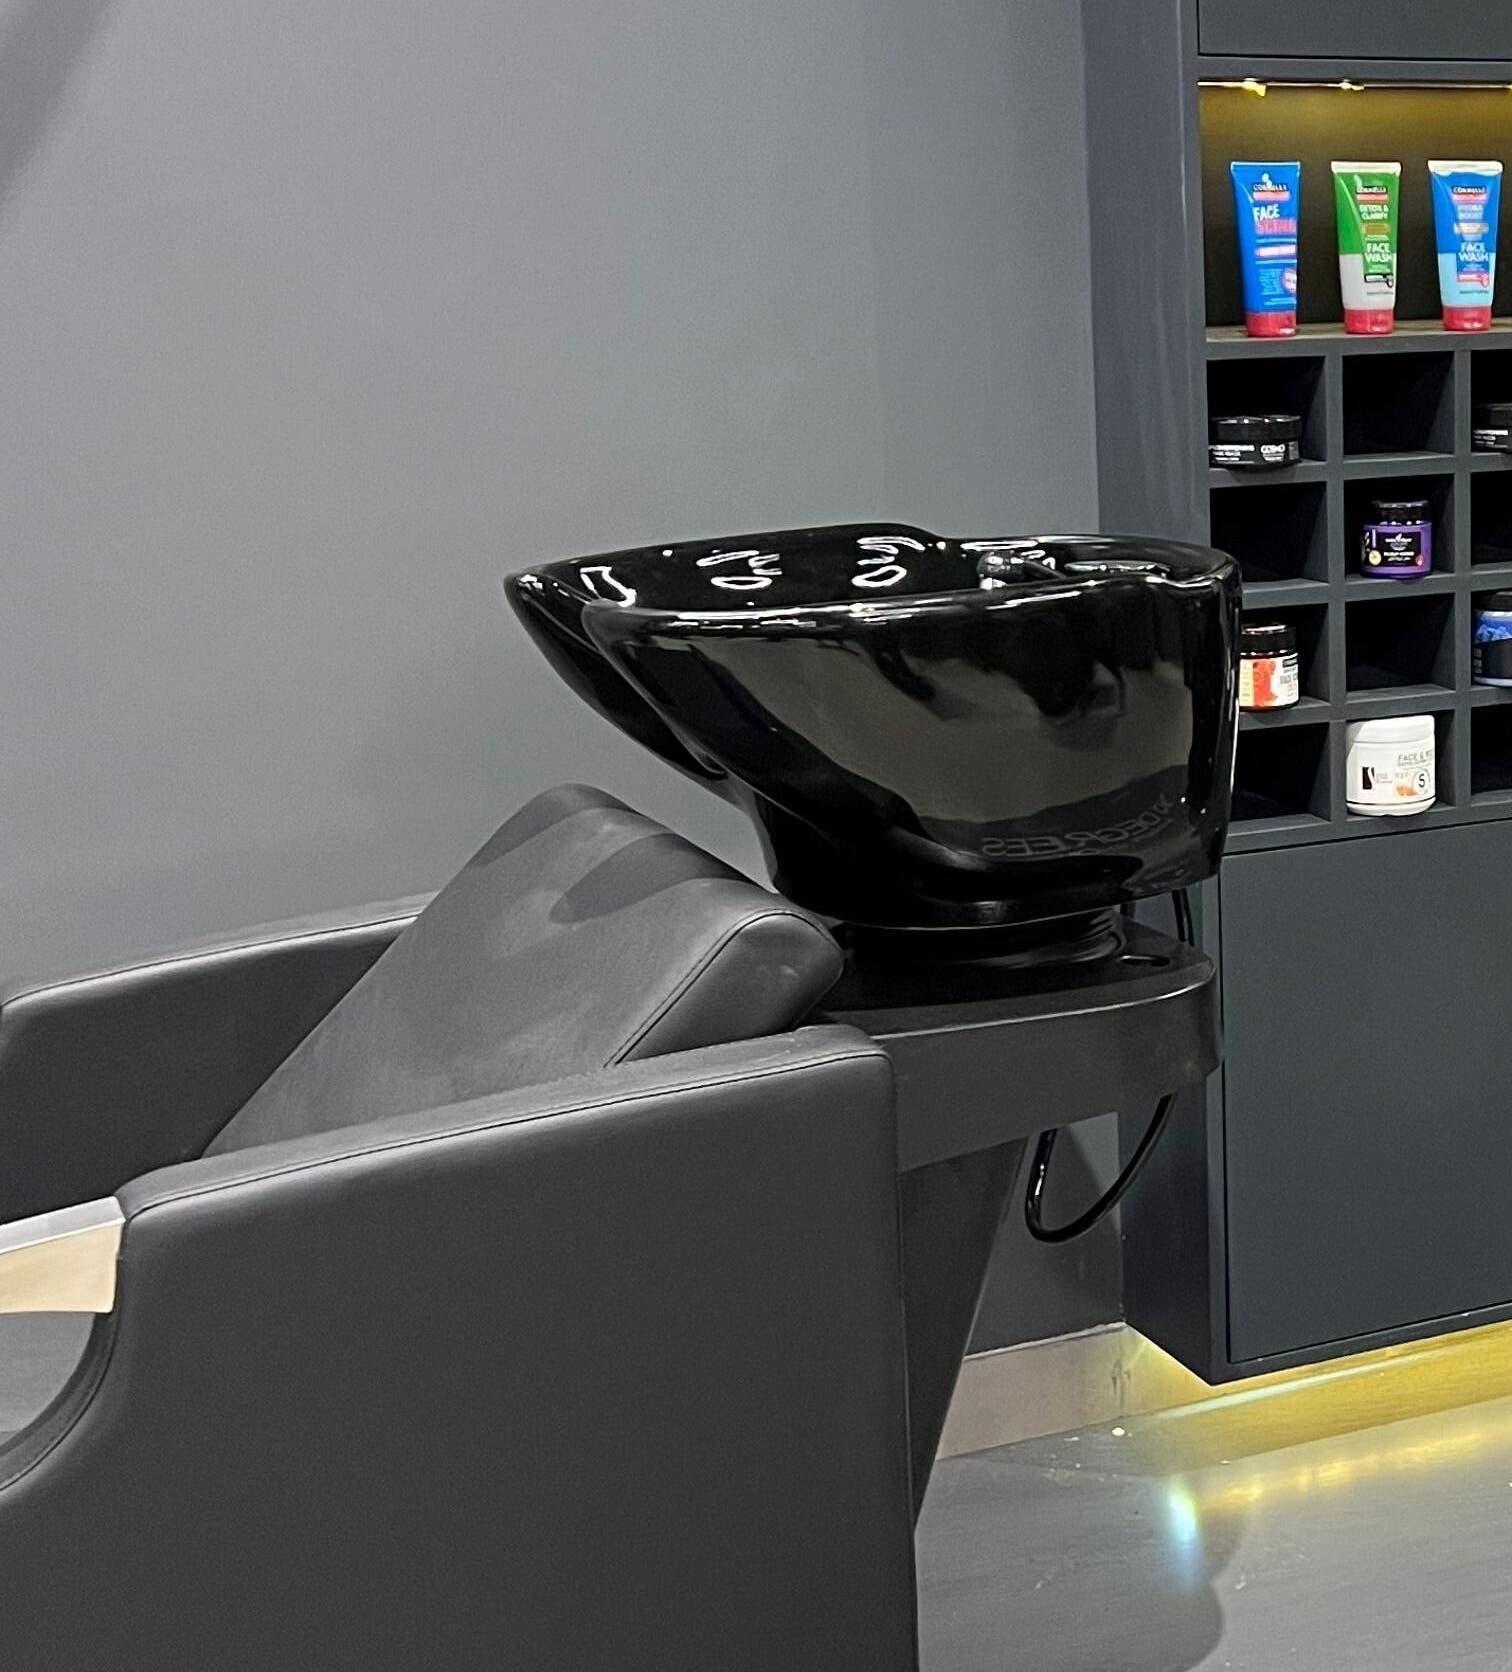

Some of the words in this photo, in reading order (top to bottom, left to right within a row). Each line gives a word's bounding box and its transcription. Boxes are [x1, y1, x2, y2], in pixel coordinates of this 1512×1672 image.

[1253, 203, 1280, 223] FACE
[1366, 242, 1390, 253] FACE
[1460, 241, 1486, 252] FACE
[1364, 251, 1393, 263] WASH
[1458, 251, 1489, 263] WASH
[1418, 773, 1426, 788] 5
